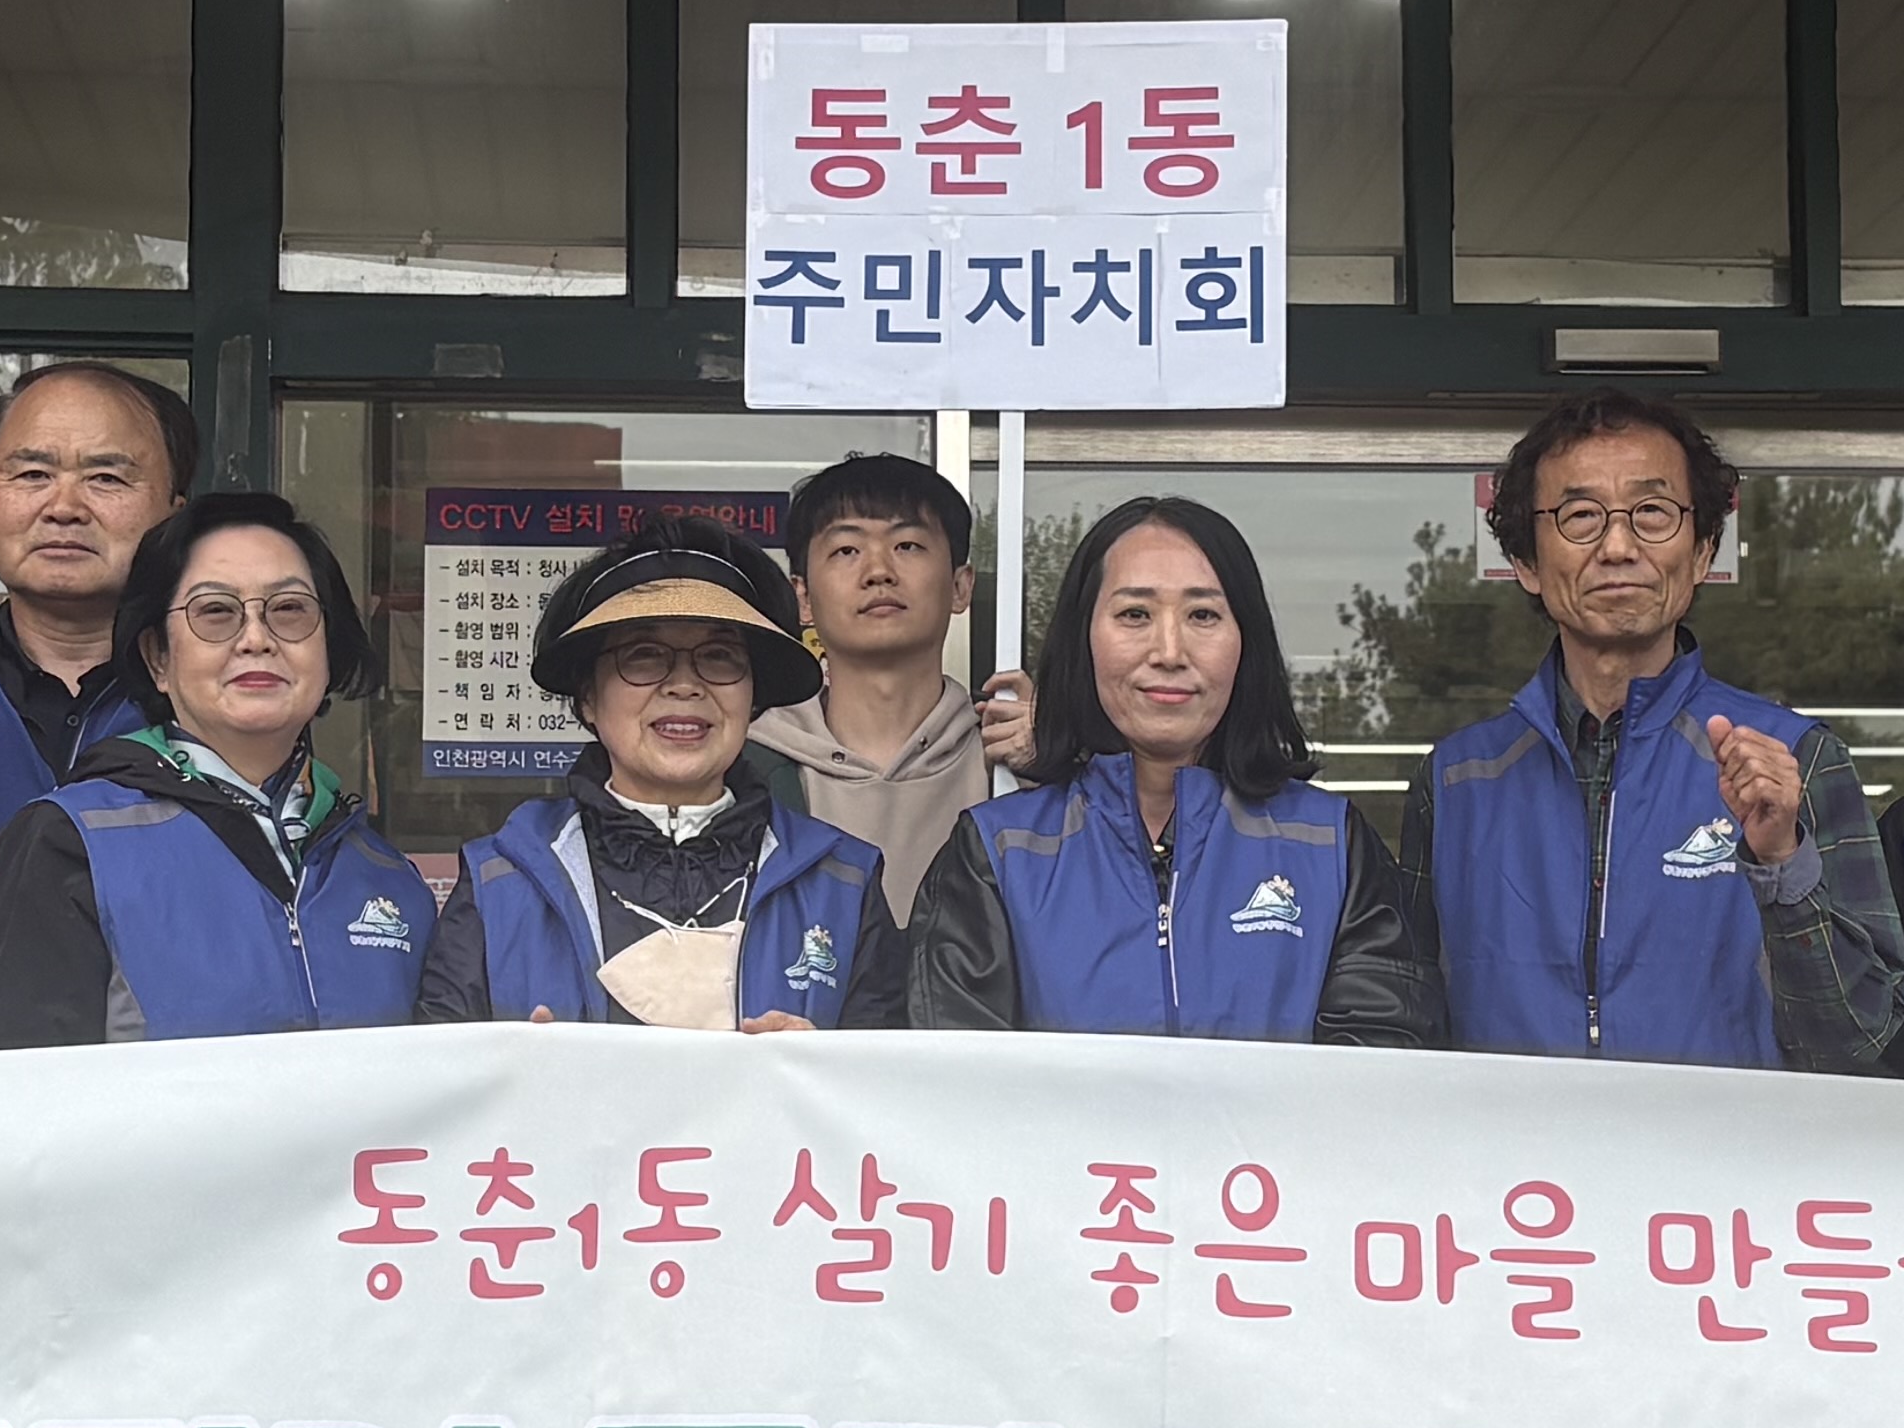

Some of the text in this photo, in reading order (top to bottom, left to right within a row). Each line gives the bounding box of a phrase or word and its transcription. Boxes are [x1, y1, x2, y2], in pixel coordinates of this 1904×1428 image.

[753, 245, 1265, 346] 주민자치회
[439, 503, 531, 531] CCTV
[546, 503, 604, 534] 설치
[455, 559, 484, 579] 설치
[490, 559, 520, 579] 목적
[455, 592, 484, 611] 설치
[490, 592, 520, 611] 장소
[490, 622, 519, 641] 범위
[490, 651, 519, 669] 시간
[433, 749, 526, 769] 인천광역시
[337, 1146, 722, 1301] 동춘1동
[773, 1148, 1008, 1303] 살기
[1079, 1162, 1308, 1319] 좋은
[1354, 1179, 1596, 1340] 마을
